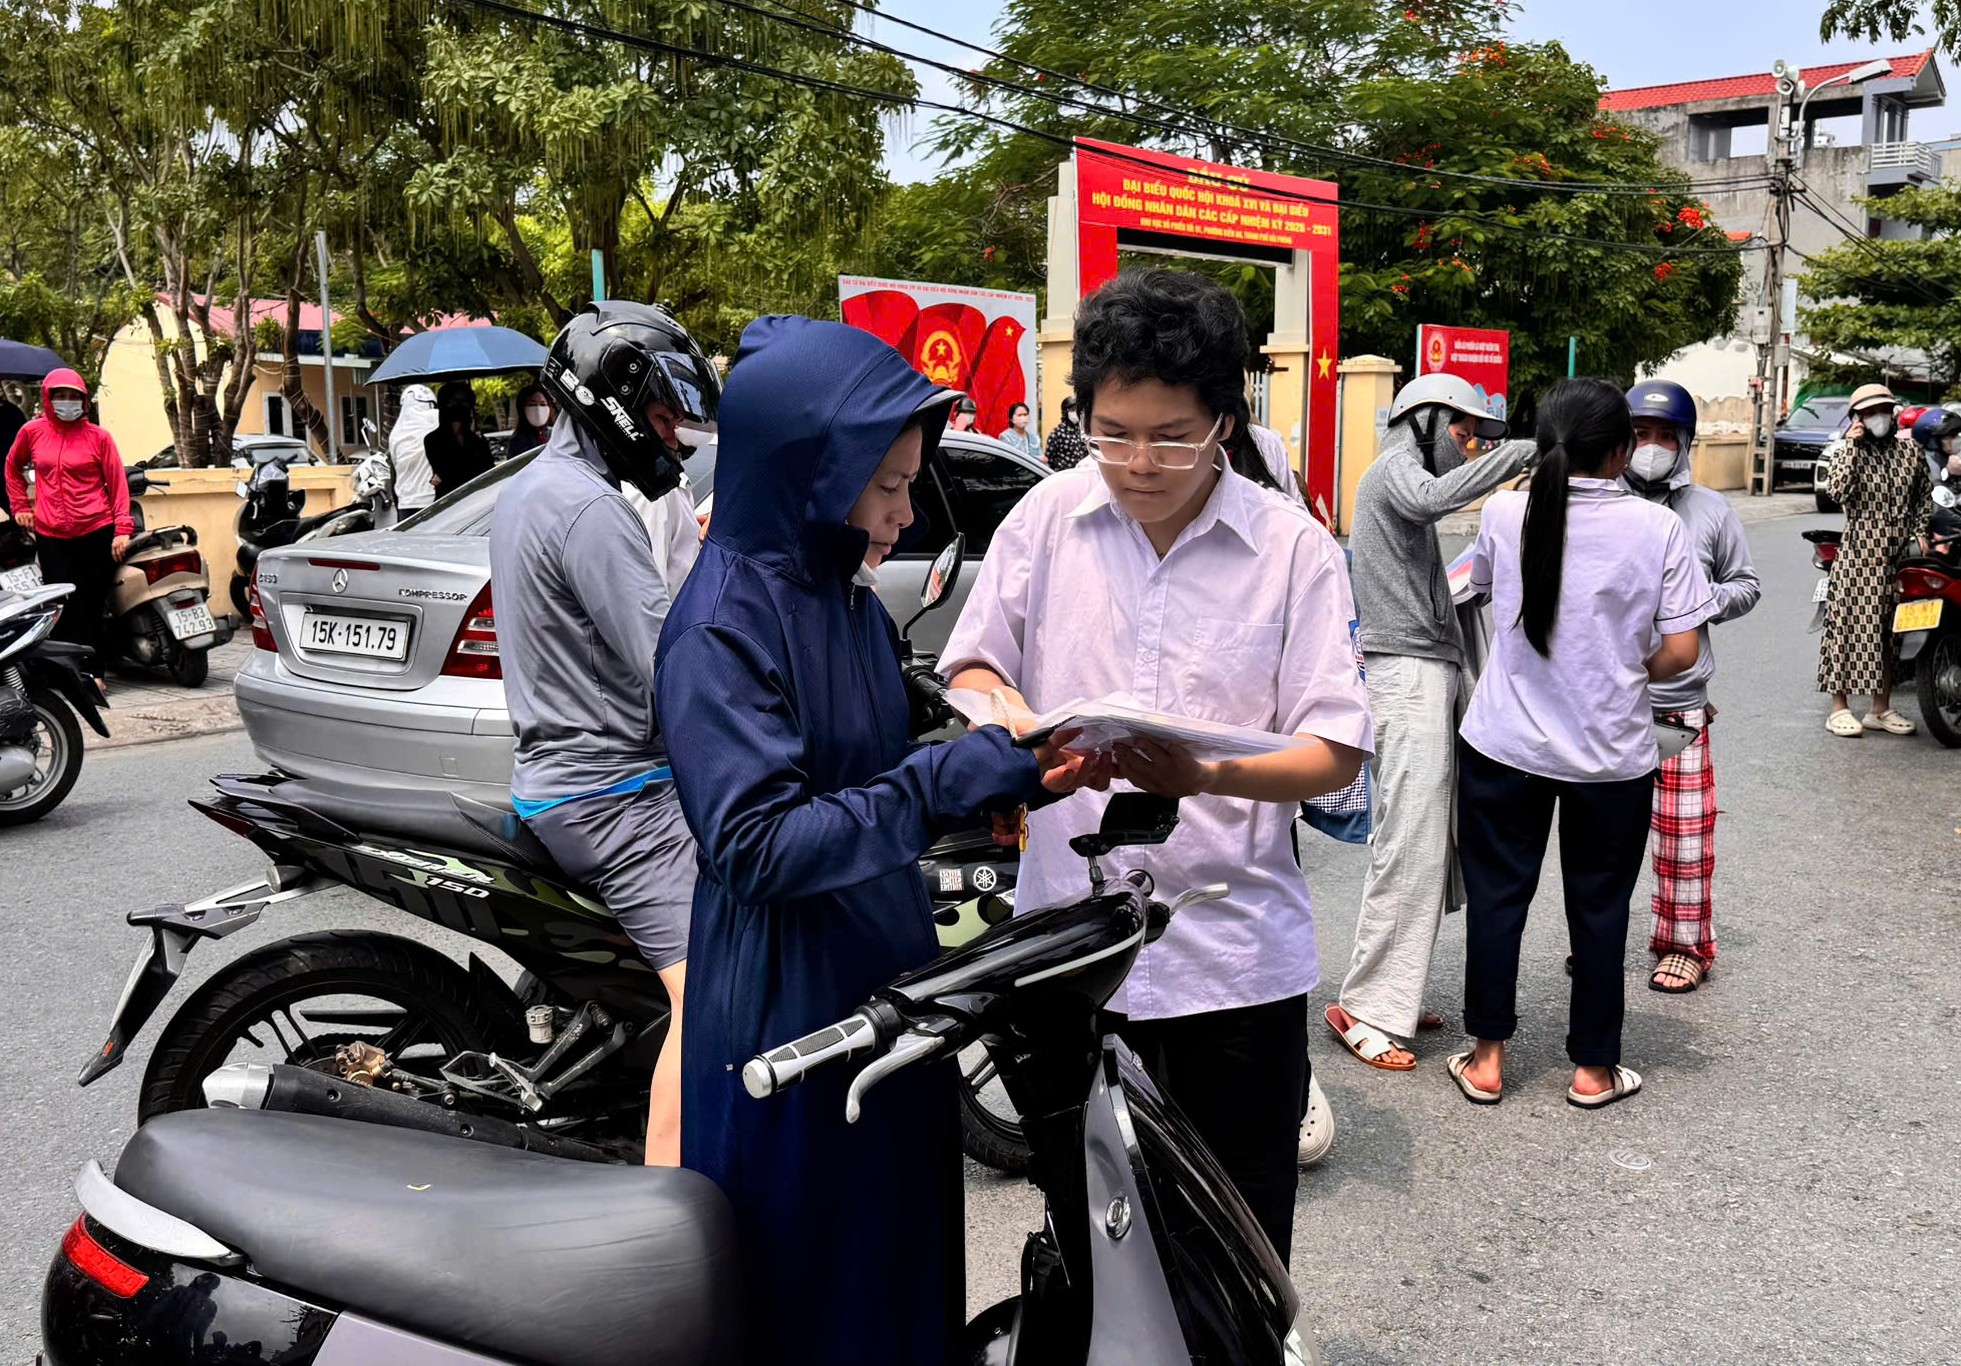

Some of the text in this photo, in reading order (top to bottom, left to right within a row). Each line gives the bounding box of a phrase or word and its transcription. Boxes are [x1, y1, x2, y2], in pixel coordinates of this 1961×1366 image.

[1122, 178, 1141, 194] ĐẠI
[1143, 180, 1167, 196] BIỂU
[1169, 185, 1195, 200] QUỐC
[1197, 190, 1214, 205] HỘI
[1092, 191, 1111, 208] HỘI
[1113, 194, 1142, 211] ĐỒNG
[1145, 199, 1174, 215] NHÂN
[1176, 204, 1196, 218] DÂN
[1198, 208, 1218, 221] CÁC
[1220, 210, 1239, 224] CẤP
[601, 396, 640, 441] SNELL
[176, 607, 205, 624] 15-B3
[427, 877, 490, 898] 150
